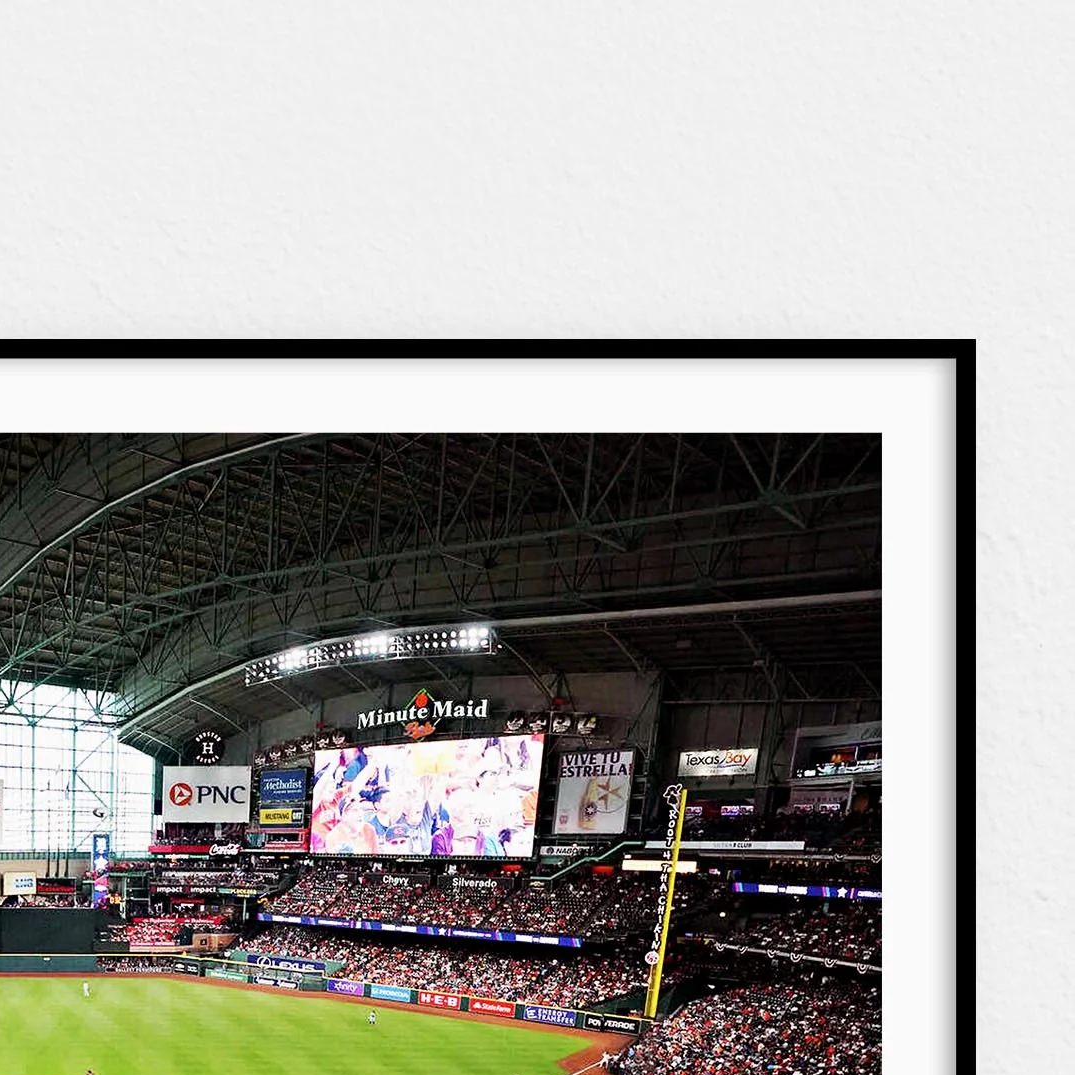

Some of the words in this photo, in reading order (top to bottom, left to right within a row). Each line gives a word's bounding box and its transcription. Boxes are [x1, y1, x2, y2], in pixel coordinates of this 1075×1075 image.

[357, 704, 428, 729] Minute
[432, 699, 488, 718] Maid
[202, 742, 214, 755] H
[602, 751, 620, 764] TU
[686, 753, 720, 766] Texas
[725, 751, 752, 767] Bay
[560, 763, 633, 778] ESTRELLA!
[263, 778, 302, 790] Methodist
[196, 785, 246, 804] PNC
[667, 809, 678, 847] ROOT
[663, 851, 671, 860] 4
[382, 875, 409, 885] Chevy
[452, 878, 498, 888] Silverado
[659, 863, 672, 892] THA
[157, 886, 183, 894] impact
[190, 886, 216, 894] impact
[650, 896, 667, 950] CHIKIN
[272, 960, 315, 971] LEXUS
[333, 981, 358, 993] xfinity
[537, 1008, 568, 1018] ENERGY
[537, 1013, 574, 1025] TRANSFER
